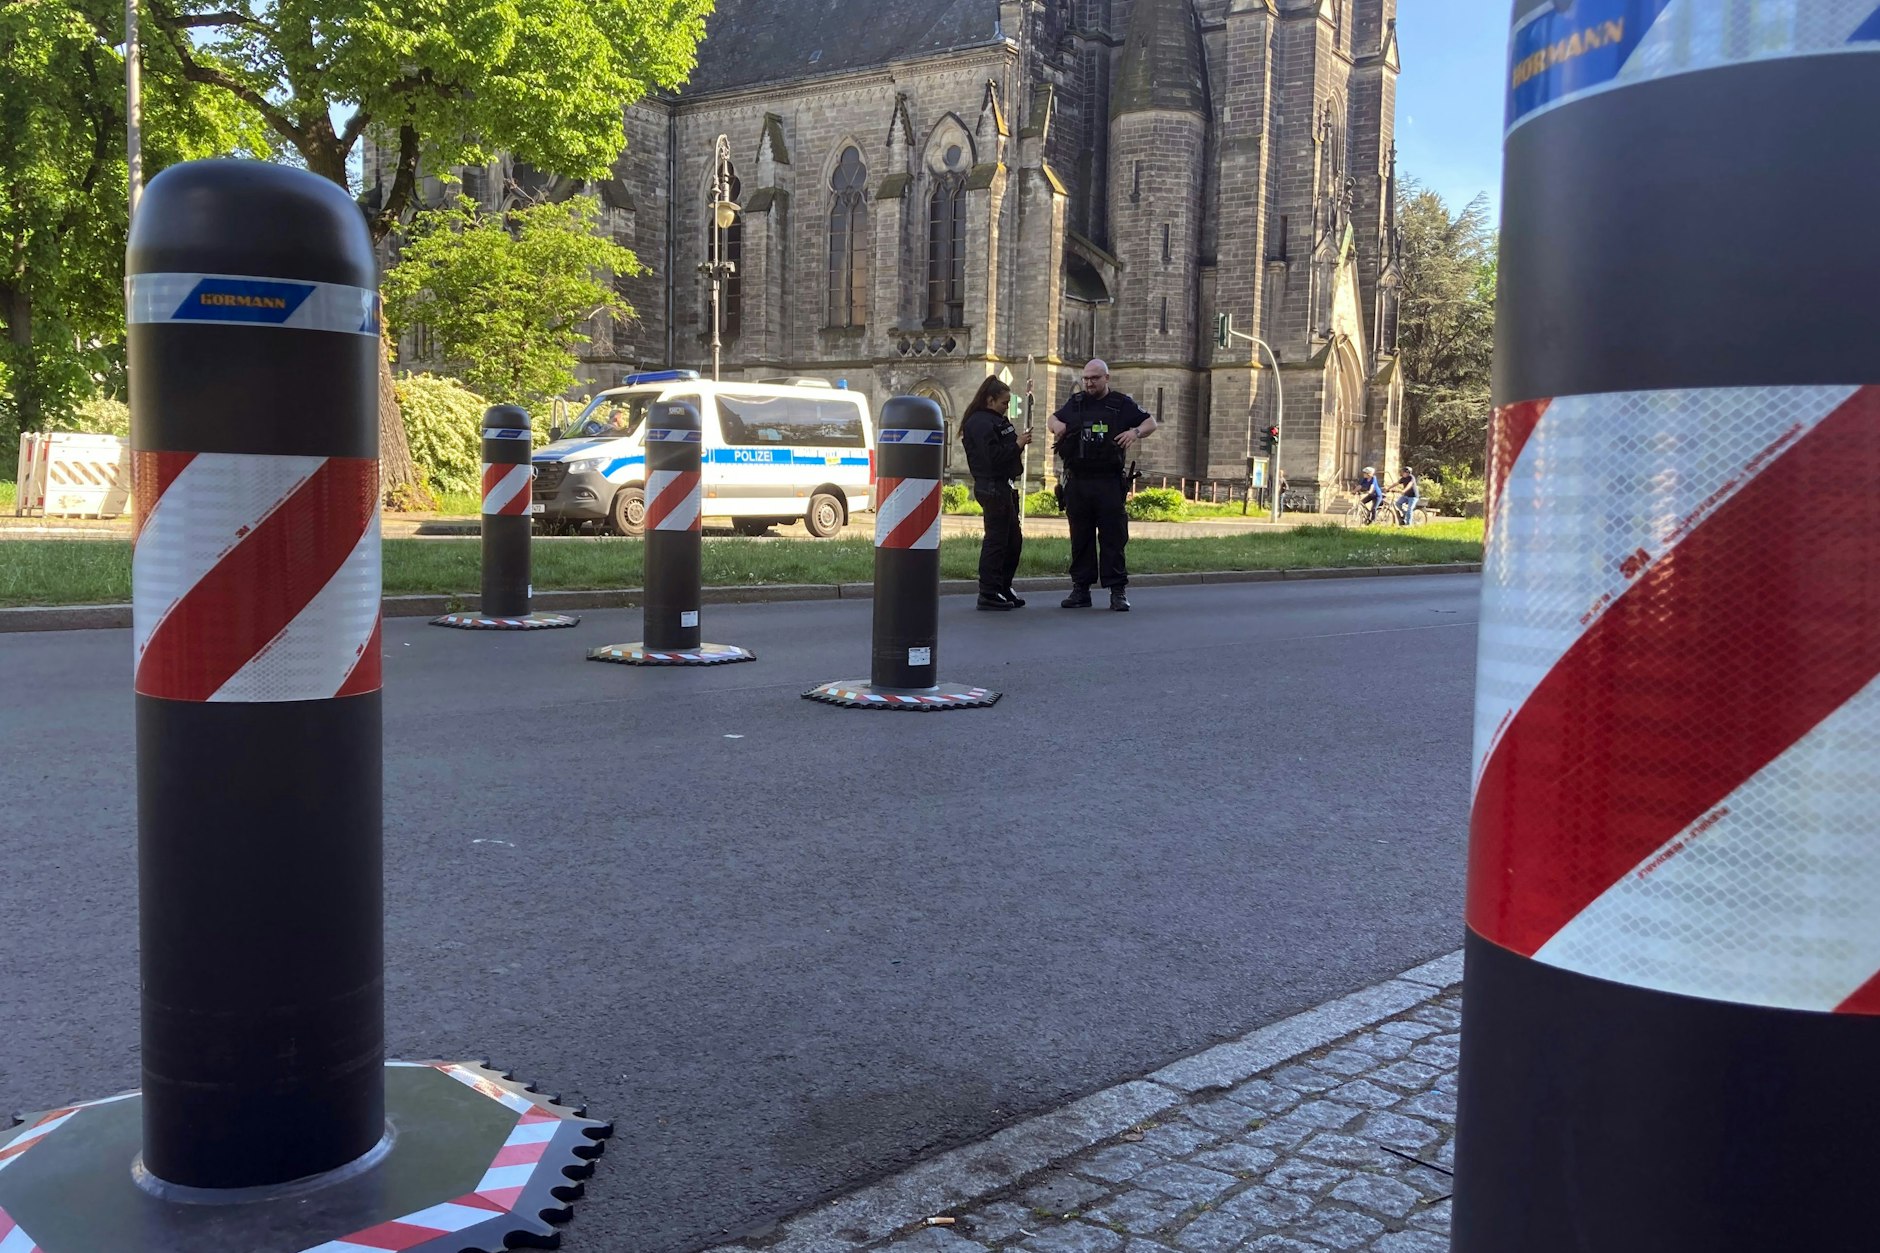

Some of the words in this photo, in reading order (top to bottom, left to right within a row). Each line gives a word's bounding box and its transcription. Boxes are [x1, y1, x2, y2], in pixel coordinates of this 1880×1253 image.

[734, 450, 773, 462] POLIZEI
[235, 524, 251, 539] 3M
[1620, 546, 1651, 579] 3M
